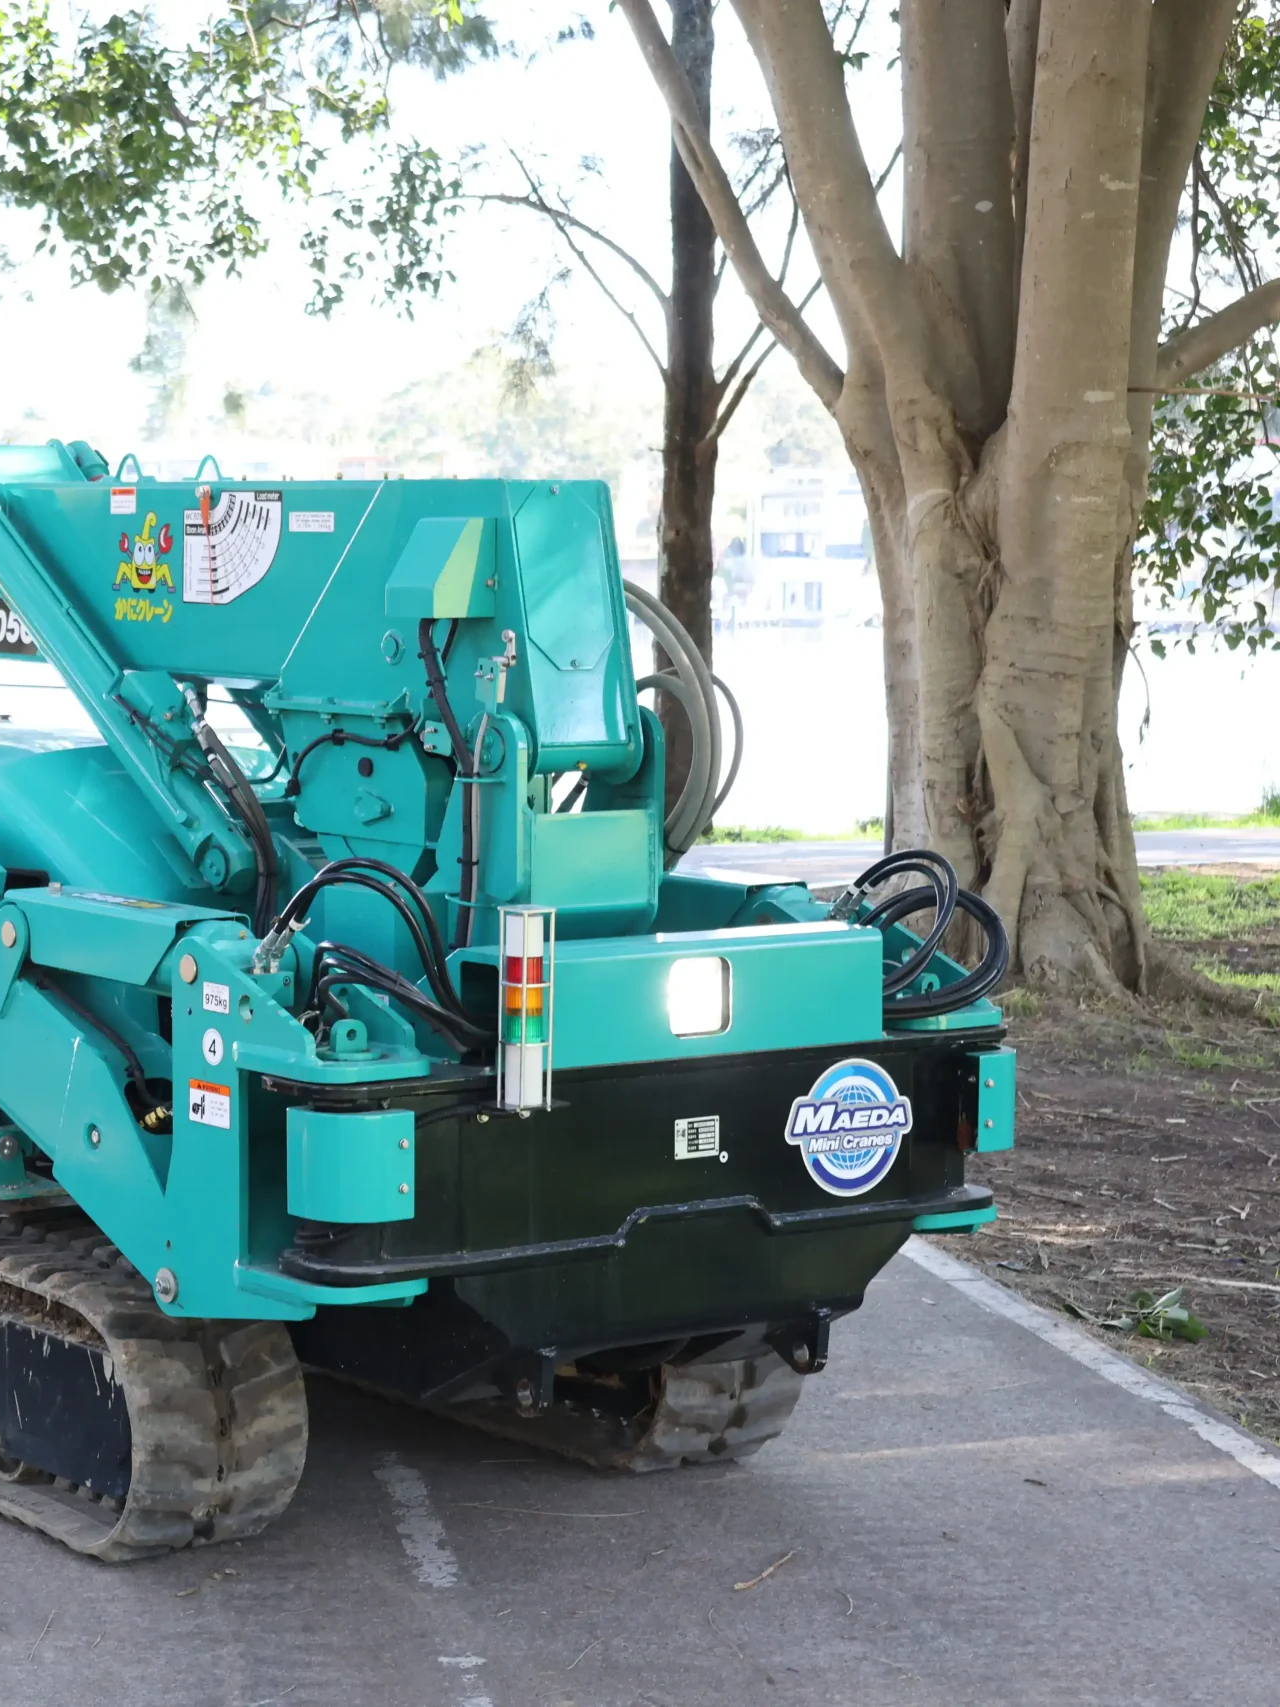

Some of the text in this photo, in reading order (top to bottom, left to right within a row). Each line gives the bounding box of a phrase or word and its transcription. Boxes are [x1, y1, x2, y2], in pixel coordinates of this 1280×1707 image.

[204, 993, 228, 1010] 975kg
[208, 1038, 217, 1057] 4
[792, 1103, 907, 1135] MAEDA
[808, 1133, 893, 1153] Mini Cranes
